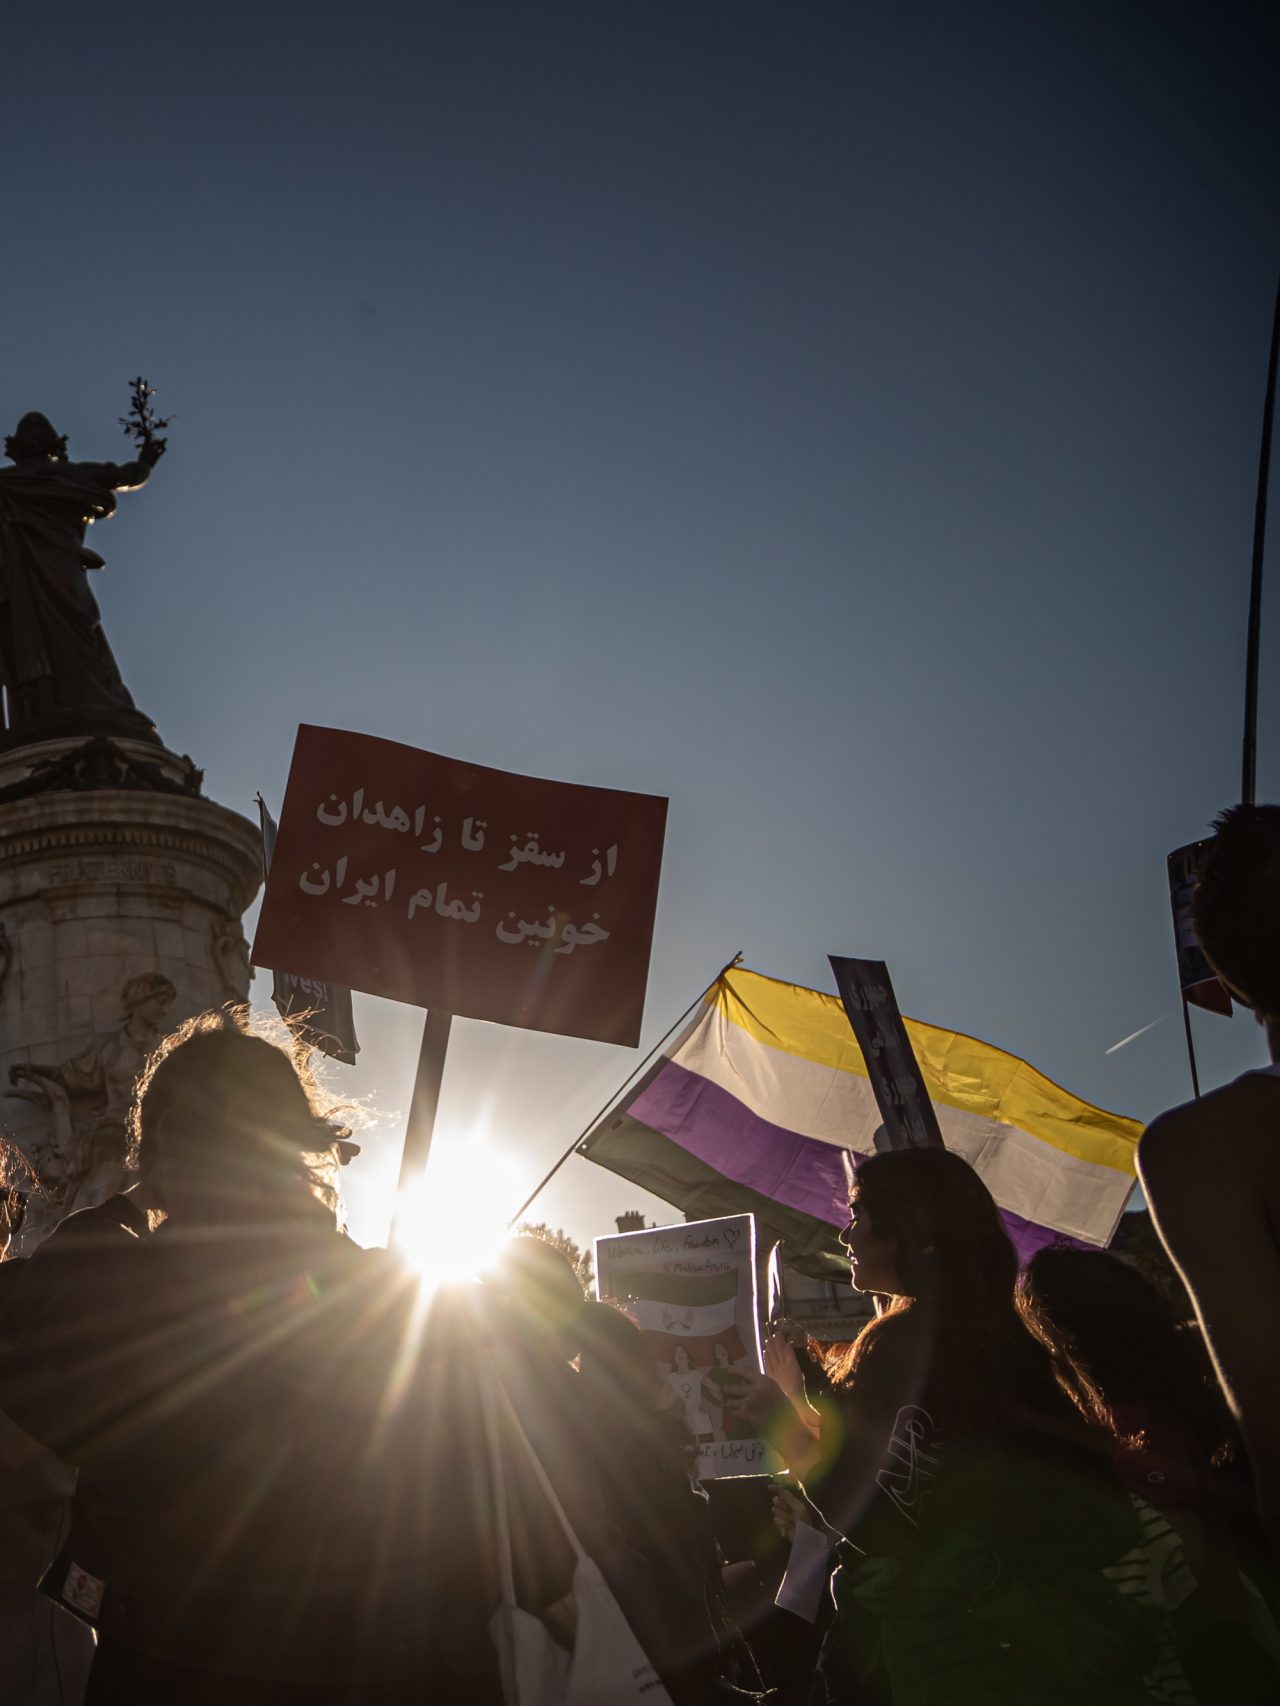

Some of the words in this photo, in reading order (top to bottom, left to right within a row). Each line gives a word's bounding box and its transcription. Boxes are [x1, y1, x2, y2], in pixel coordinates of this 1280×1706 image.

[316, 788, 444, 853] زاهدان
[460, 816, 488, 851] تا
[497, 832, 566, 871] سقز
[580, 844, 619, 886] از
[299, 856, 396, 909] ایران
[408, 882, 484, 922] تمام
[495, 904, 610, 954] خونین
